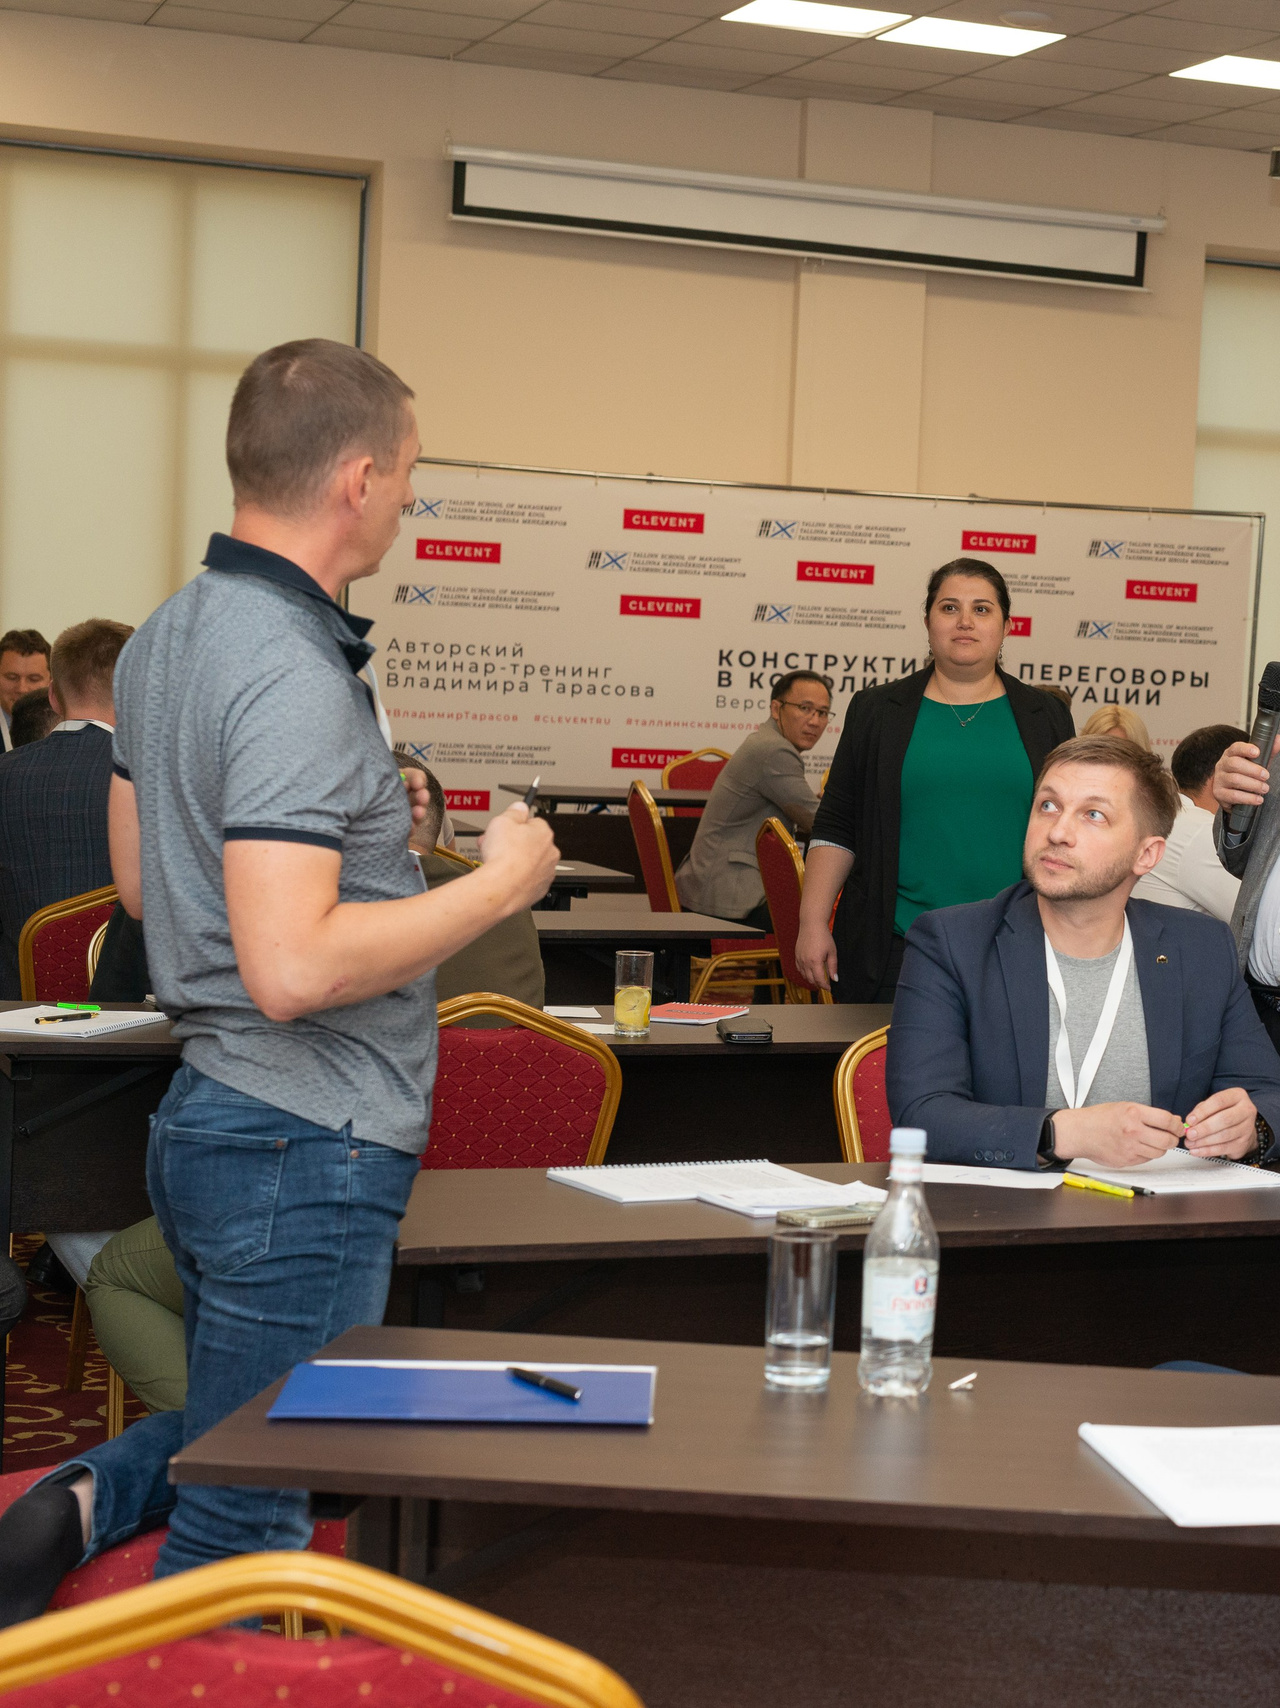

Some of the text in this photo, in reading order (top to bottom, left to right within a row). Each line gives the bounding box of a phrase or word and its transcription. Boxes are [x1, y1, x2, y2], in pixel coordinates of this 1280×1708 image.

[632, 515, 696, 528] CLEVENT
[970, 536, 1029, 549] CLEVENT
[425, 545, 492, 558] CLEVENT
[805, 566, 867, 579] CLEVENT
[1133, 585, 1190, 597] CLEVENT
[629, 600, 693, 613] CLEVENT
[387, 638, 523, 658] Авторский
[386, 658, 612, 679] семинар-тренинг
[1020, 664, 1209, 688] ПЕРЕГОВОРЫ
[386, 672, 655, 698] Владимира Тарасова
[718, 671, 732, 688] В
[1050, 685, 1161, 706] УАЦИИ
[716, 696, 766, 712] Верс
[386, 708, 519, 722] #ВладимирТарасов
[534, 716, 611, 725] #CLEVENTRU
[621, 753, 683, 765] CLEVEN
[445, 795, 482, 806] VENT
